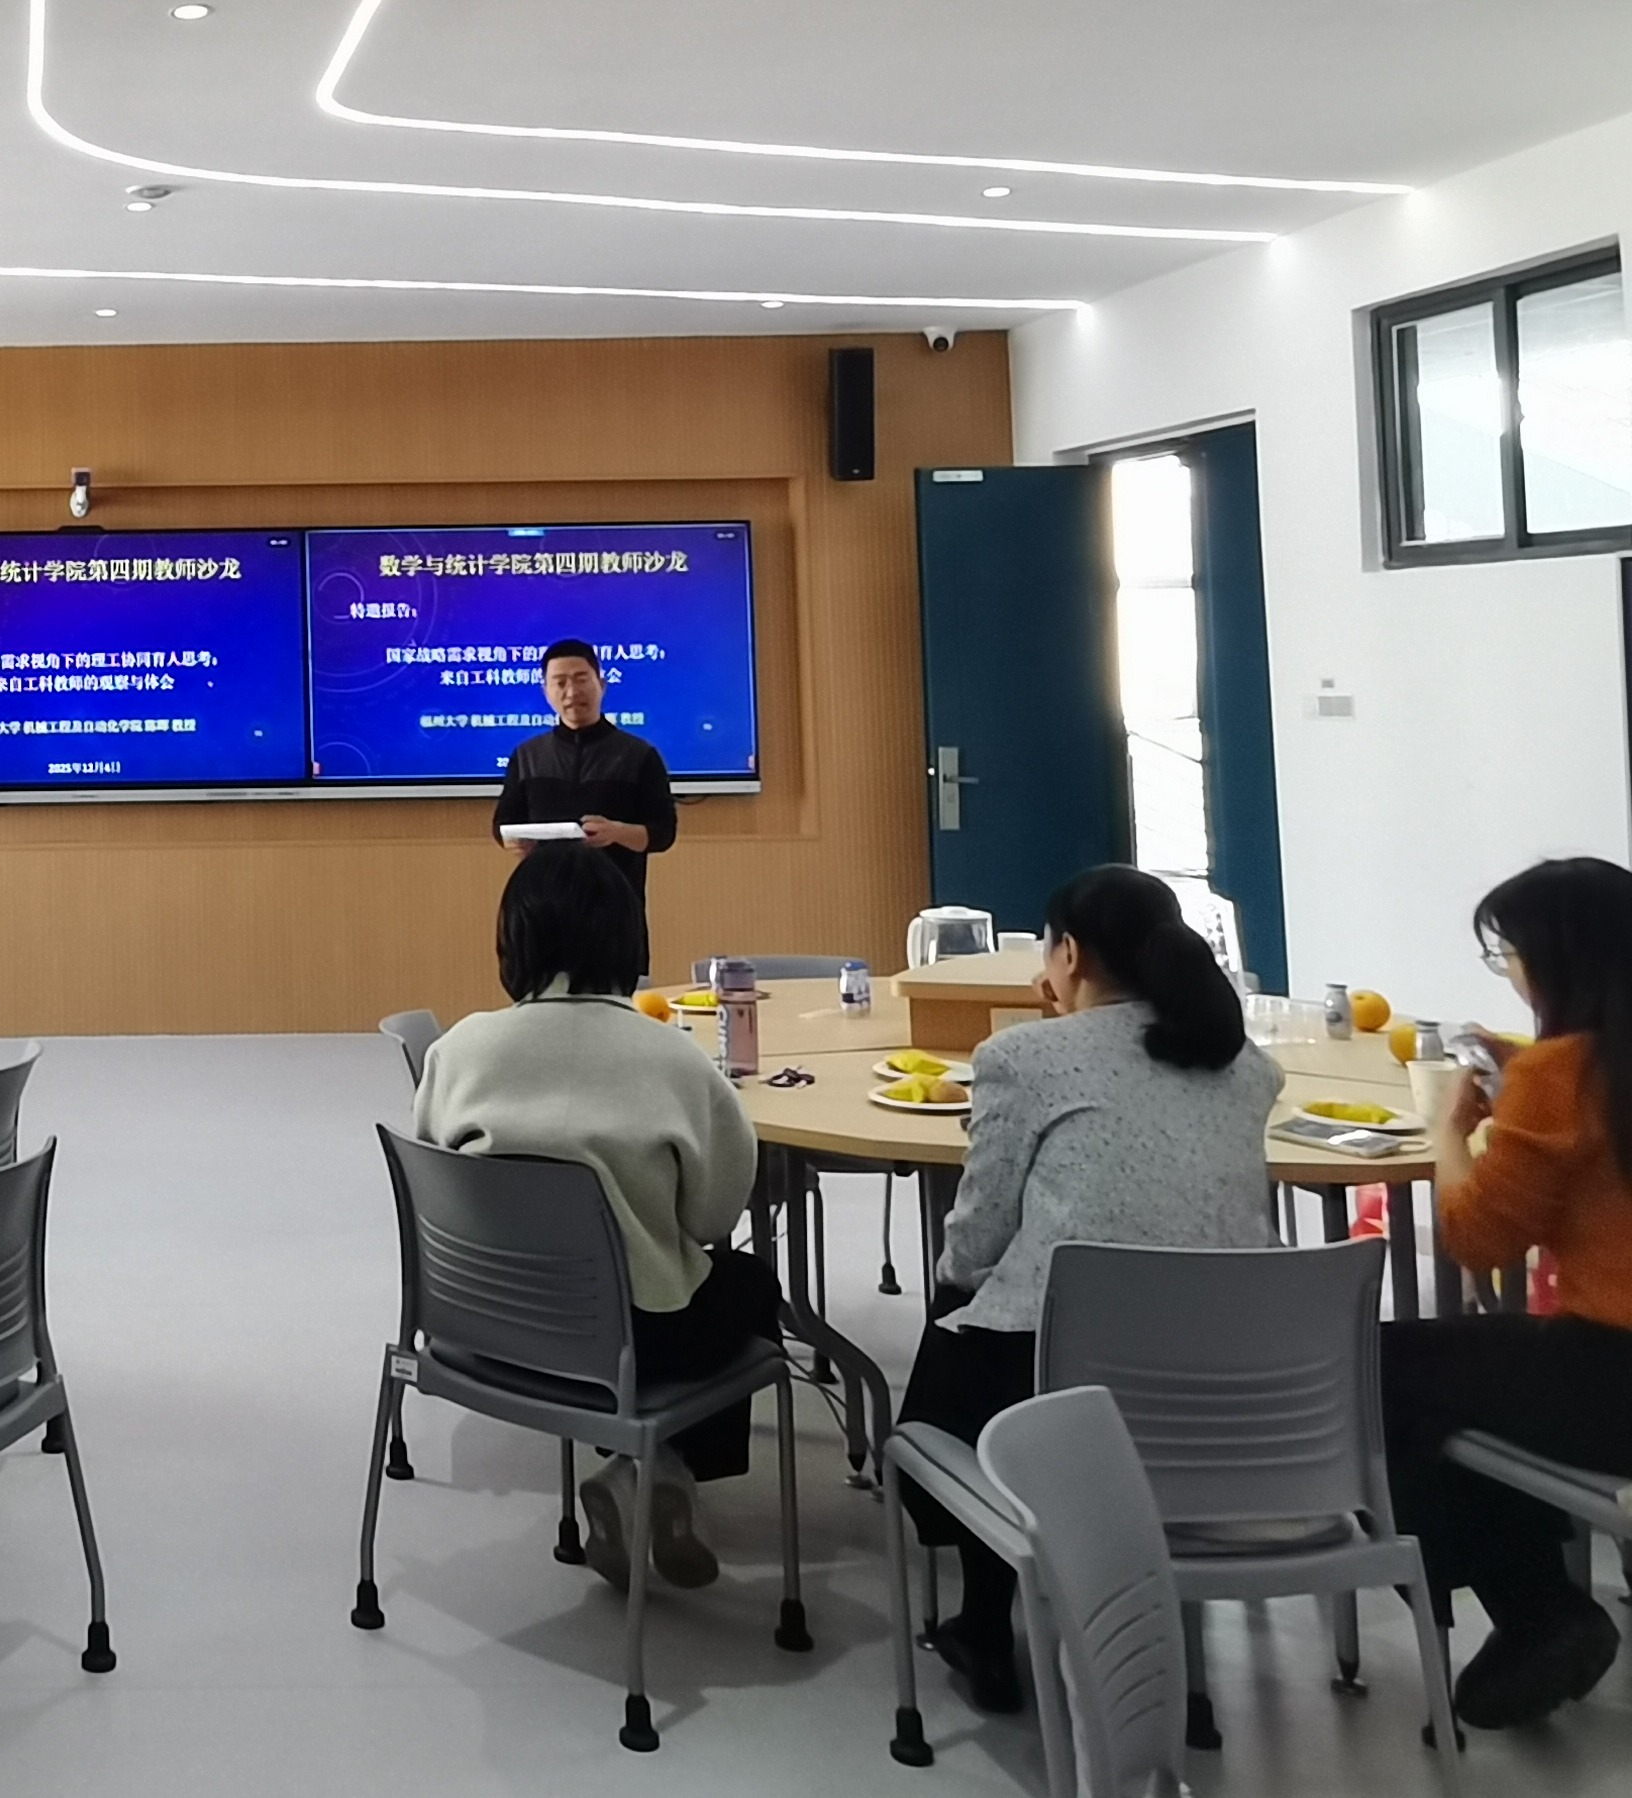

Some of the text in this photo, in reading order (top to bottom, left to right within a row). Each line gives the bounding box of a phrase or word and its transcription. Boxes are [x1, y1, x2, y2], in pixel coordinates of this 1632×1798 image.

[379, 550, 689, 577] 数学与统计学院第四期教师沙龙
